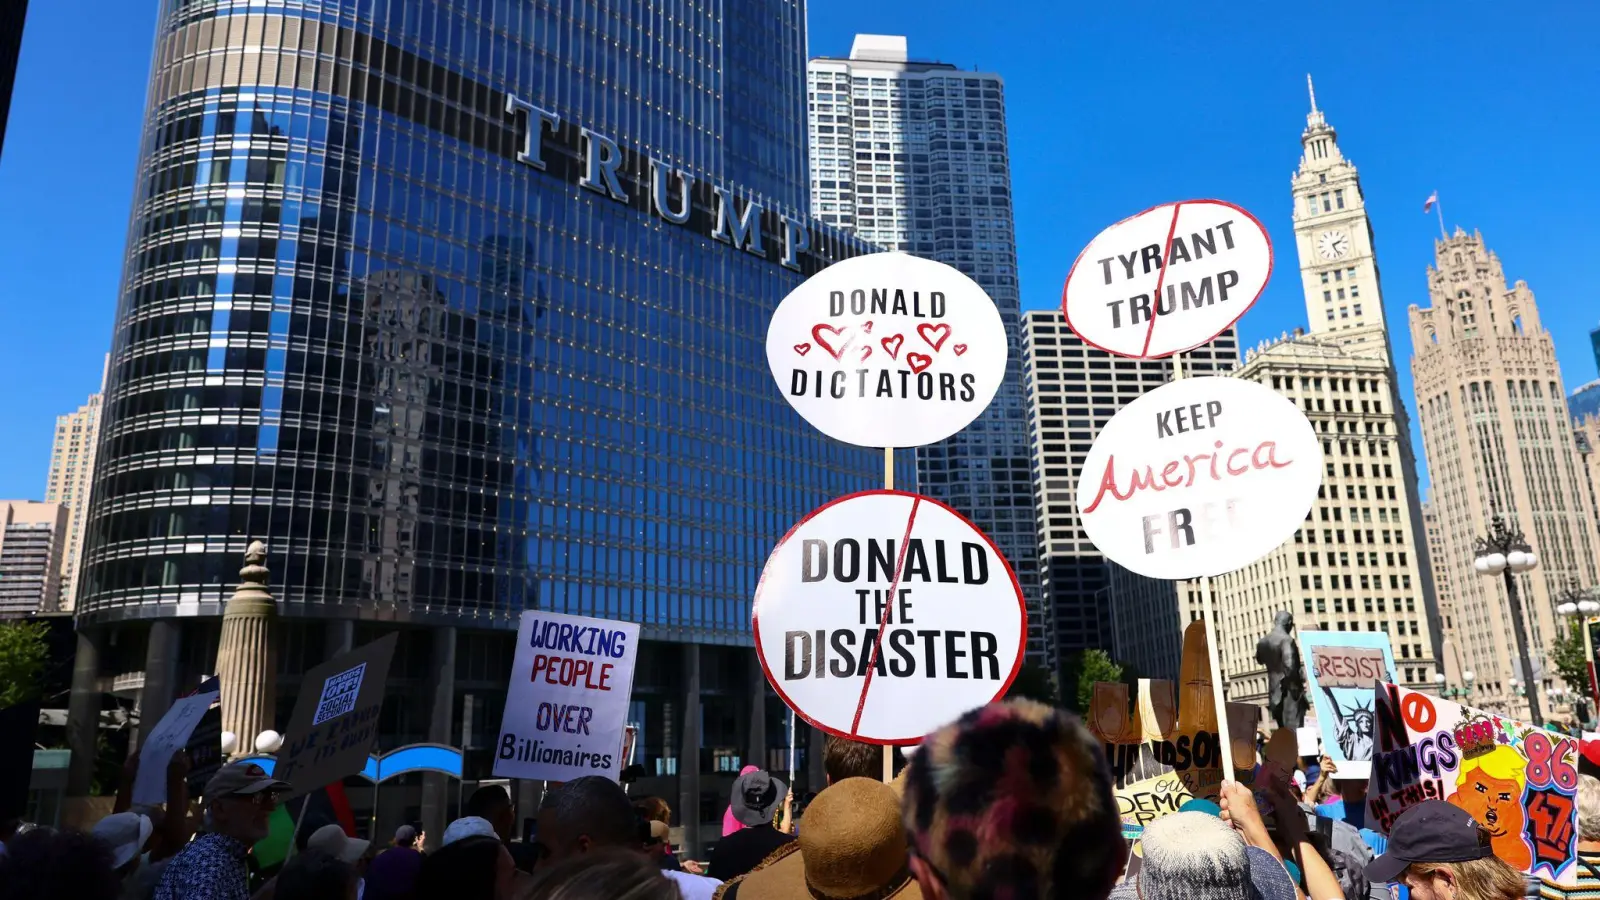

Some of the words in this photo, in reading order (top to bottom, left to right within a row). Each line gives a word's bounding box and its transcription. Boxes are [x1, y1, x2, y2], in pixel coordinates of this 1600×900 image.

[505, 92, 810, 272] TRUMP
[1097, 219, 1236, 285] TYRANT
[829, 288, 946, 318] DONALD
[1106, 269, 1240, 329] TRUMP
[790, 367, 976, 402] DICTATORS
[1156, 400, 1223, 439] KEEP
[1082, 440, 1293, 514] America
[801, 537, 990, 585] DONALD
[855, 588, 914, 624] THE
[530, 619, 627, 658] WORKING
[784, 628, 1001, 681] DISASTER
[328, 667, 362, 688] HANDS
[530, 654, 614, 691] PEOPLE
[1318, 654, 1382, 678] RESIST
[319, 691, 355, 714] SOCIAL
[325, 676, 359, 699] OFF!
[315, 702, 353, 723] SECURITY
[536, 701, 593, 736] OVER
[1374, 683, 1437, 752] NO
[499, 733, 613, 770] Billionaires
[1372, 730, 1459, 794] KINGS
[1155, 772, 1199, 794] our
[1369, 793, 1390, 821] IN
